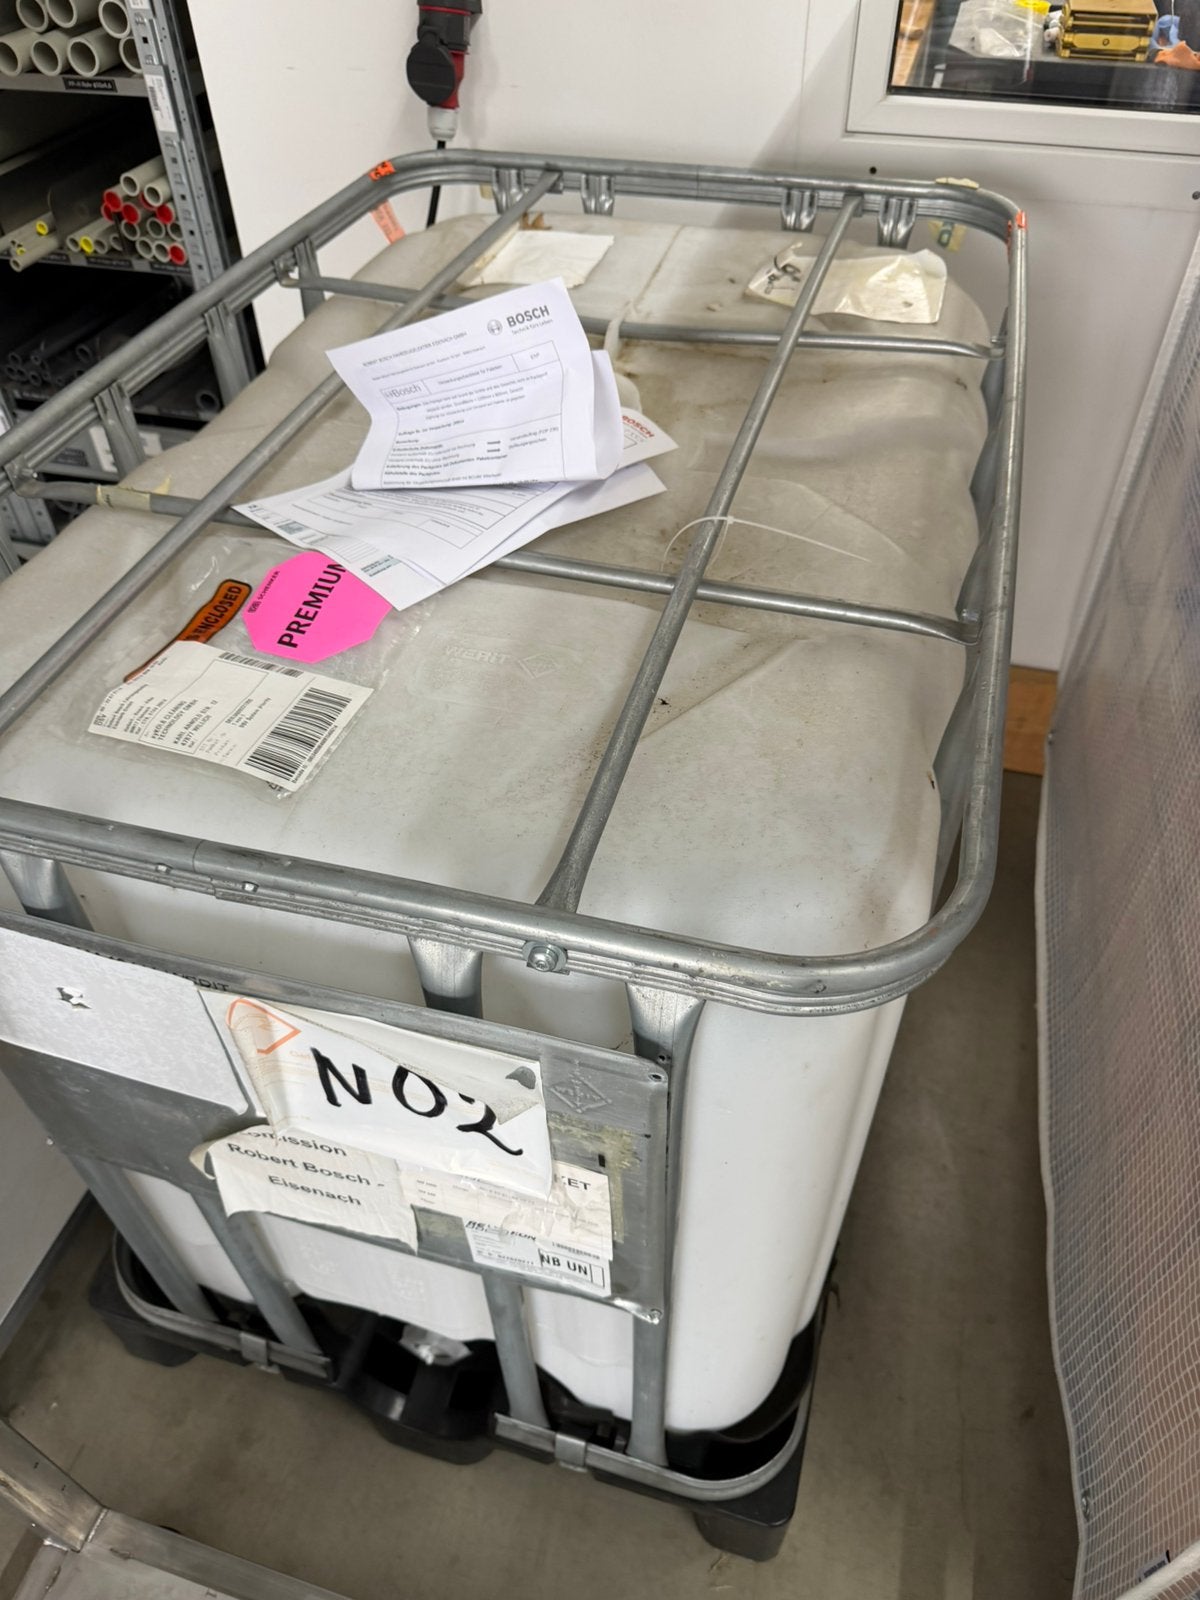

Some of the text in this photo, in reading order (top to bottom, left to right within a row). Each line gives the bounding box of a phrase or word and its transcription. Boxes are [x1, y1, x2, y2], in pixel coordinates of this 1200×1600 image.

[506, 304, 550, 328] BOSCH
[227, 1142, 298, 1168] Robert
[302, 1160, 371, 1187] Bosch
[268, 1175, 362, 1206] Eisenach
[566, 1260, 588, 1276] UN
